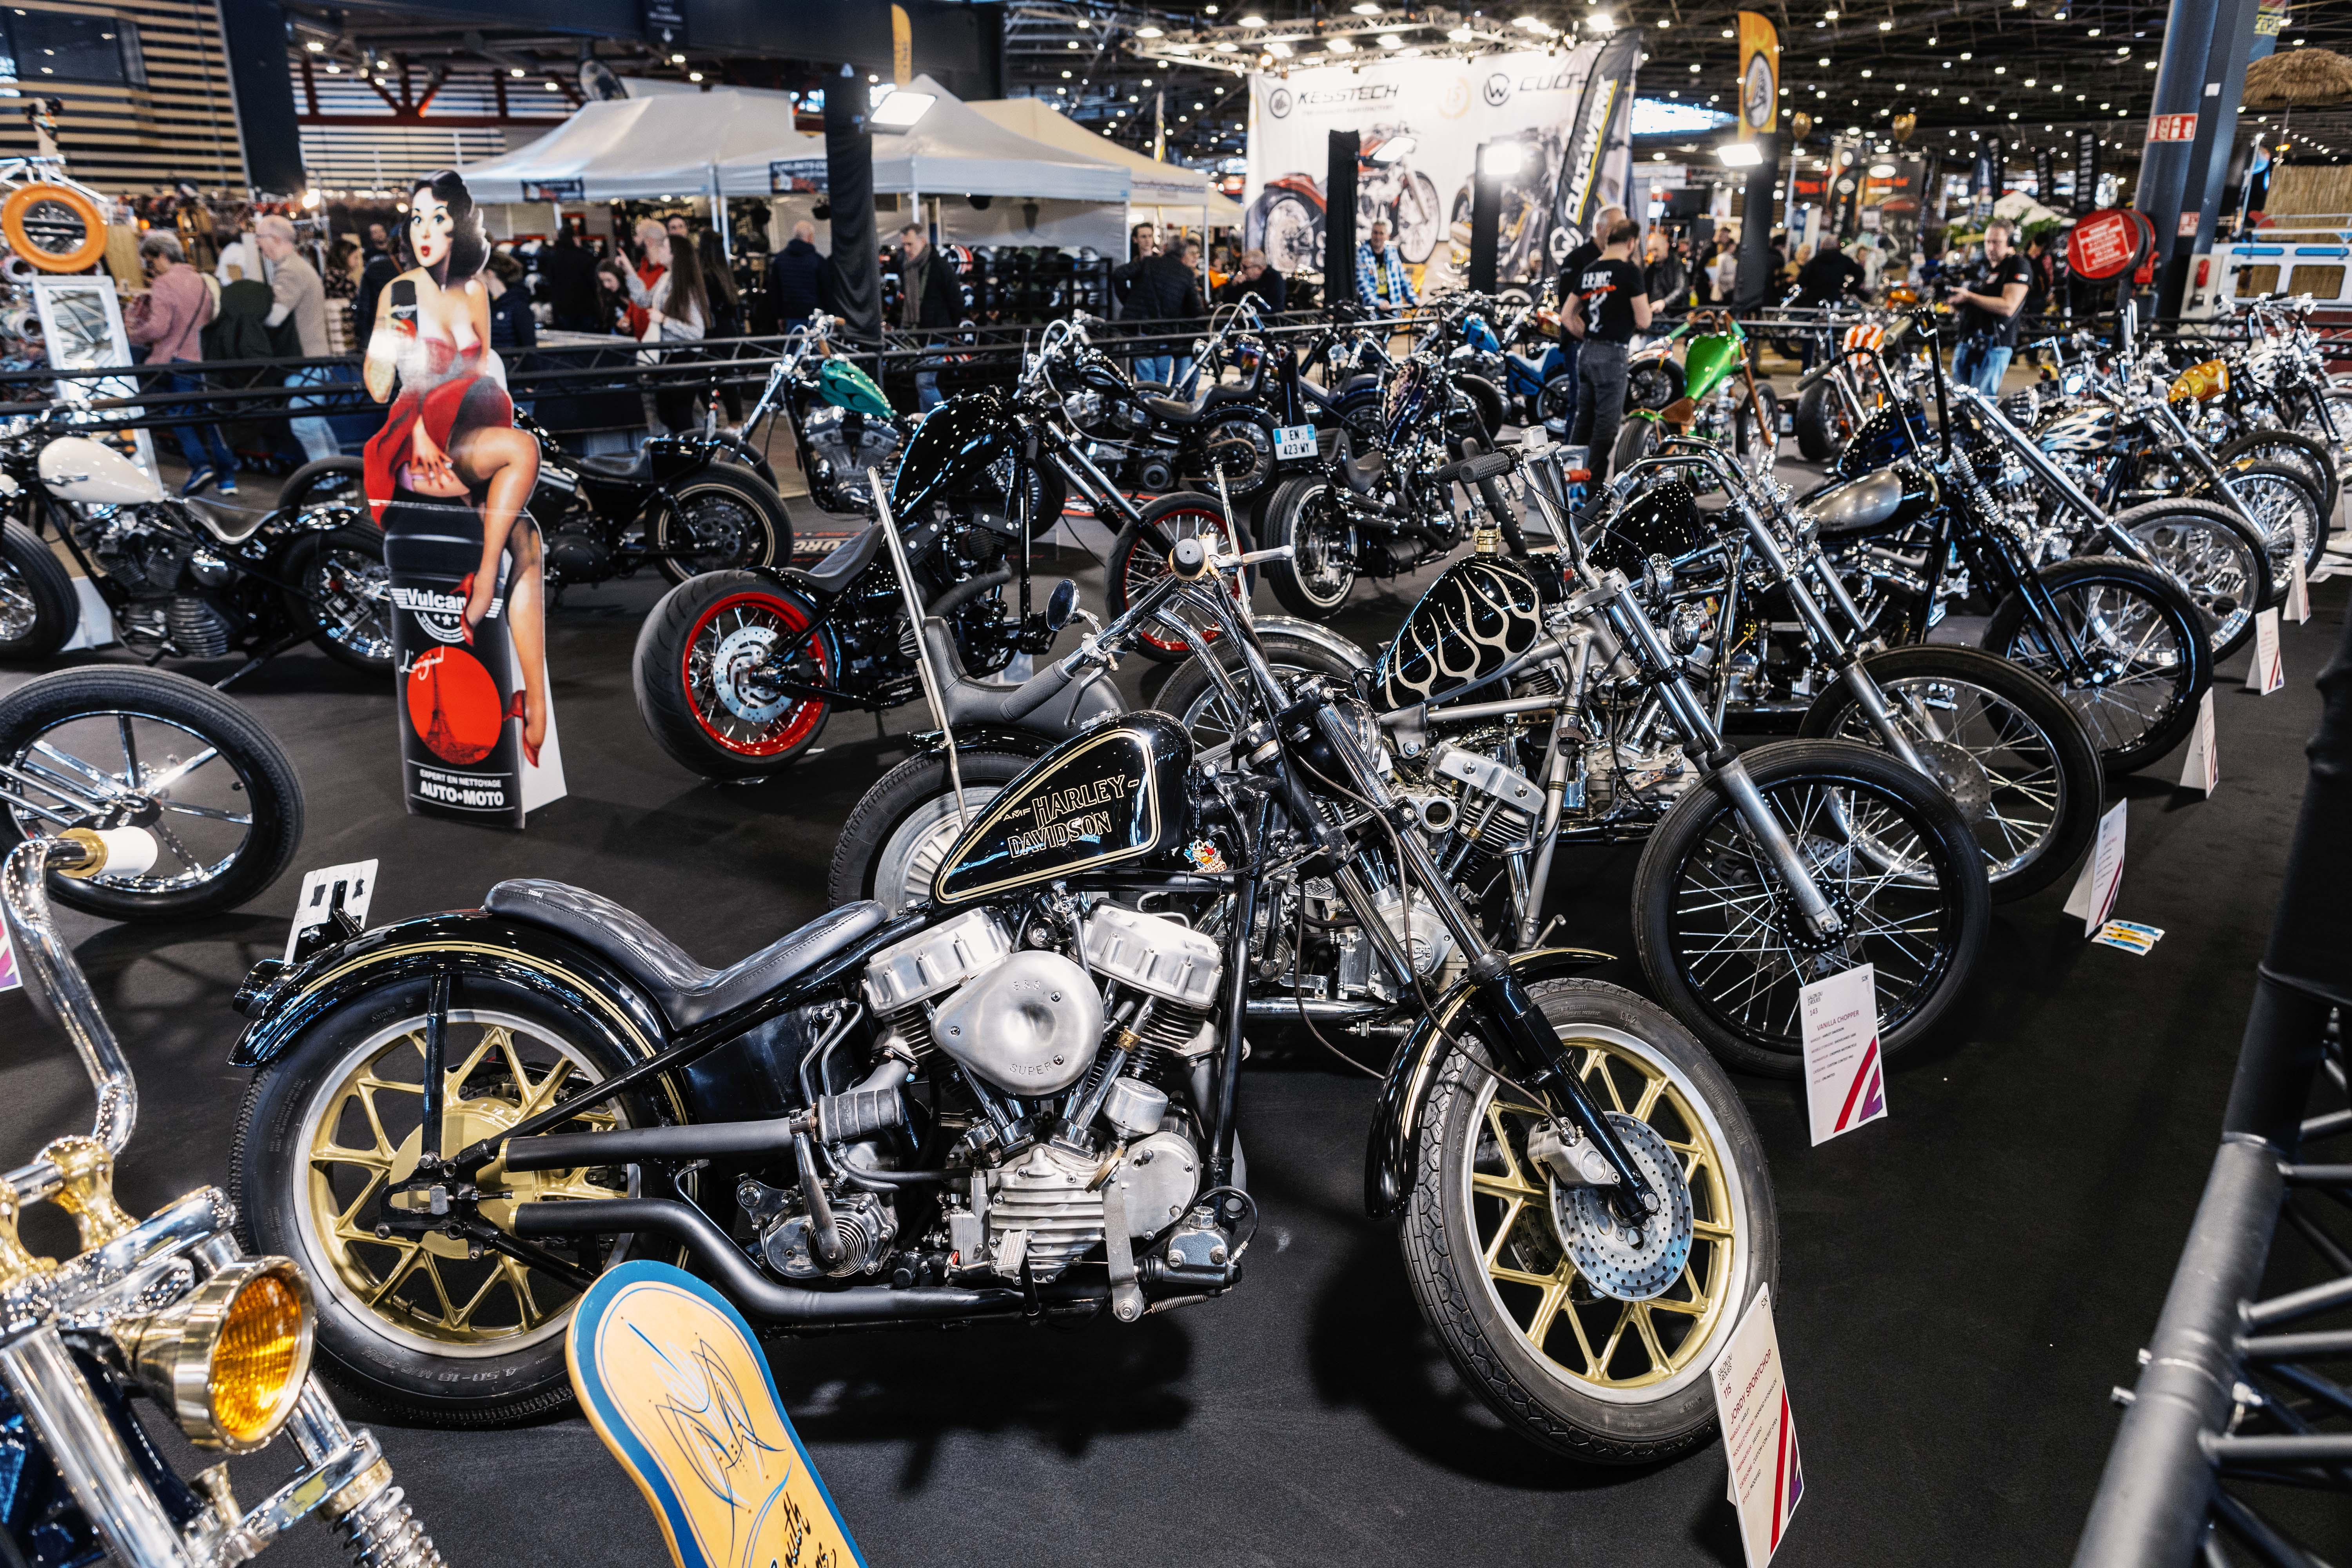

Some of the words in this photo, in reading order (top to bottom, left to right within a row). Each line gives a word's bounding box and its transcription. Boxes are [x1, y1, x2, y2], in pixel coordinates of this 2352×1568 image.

[1519, 73, 1587, 91] CULT-
[1298, 84, 1399, 104] KESSTECH
[1564, 73, 1613, 224] CULT-WERK
[1289, 429, 1299, 440] EN
[407, 588, 466, 610] Vulcan
[419, 769, 445, 782] EXPERT
[446, 775, 458, 784] EN
[459, 777, 502, 788] NETTOYAGE
[1003, 808, 1031, 821] AMF
[1007, 811, 1112, 858] DAVIDSON
[1210, 864, 1227, 873] PPER
[1810, 997, 1821, 1005] ROUES
[1620, 1011, 1637, 1025] RB2
[1810, 1008, 1818, 1016] 143
[1817, 1019, 1837, 1031] VANILLA
[1837, 1010, 1859, 1023] CHOPPER
[1010, 1062, 1053, 1076] SUPER
[1693, 1063, 1749, 1145] Continental
[437, 1367, 517, 1383] 4.50-18
[1718, 1361, 1728, 1378] SALON
[1727, 1352, 1733, 1363] DU
[1722, 1363, 1732, 1383] ROUES
[1731, 1392, 1746, 1424] JORDY
[1746, 1348, 1771, 1397] SPORTCHOP
[1754, 1401, 1764, 1421] PANHEAD
[1764, 1378, 1777, 1403] HYDRAGLIDE
[1730, 1423, 1740, 1443] MARQUE
[1741, 1406, 1750, 1424] HARLEY
[1752, 1426, 1762, 1445] SAVERIO
[1753, 1445, 1762, 1465] CUSTOM
[1762, 1427, 1772, 1448] CONTEST
[1750, 1469, 1761, 1490] MODIFIED
